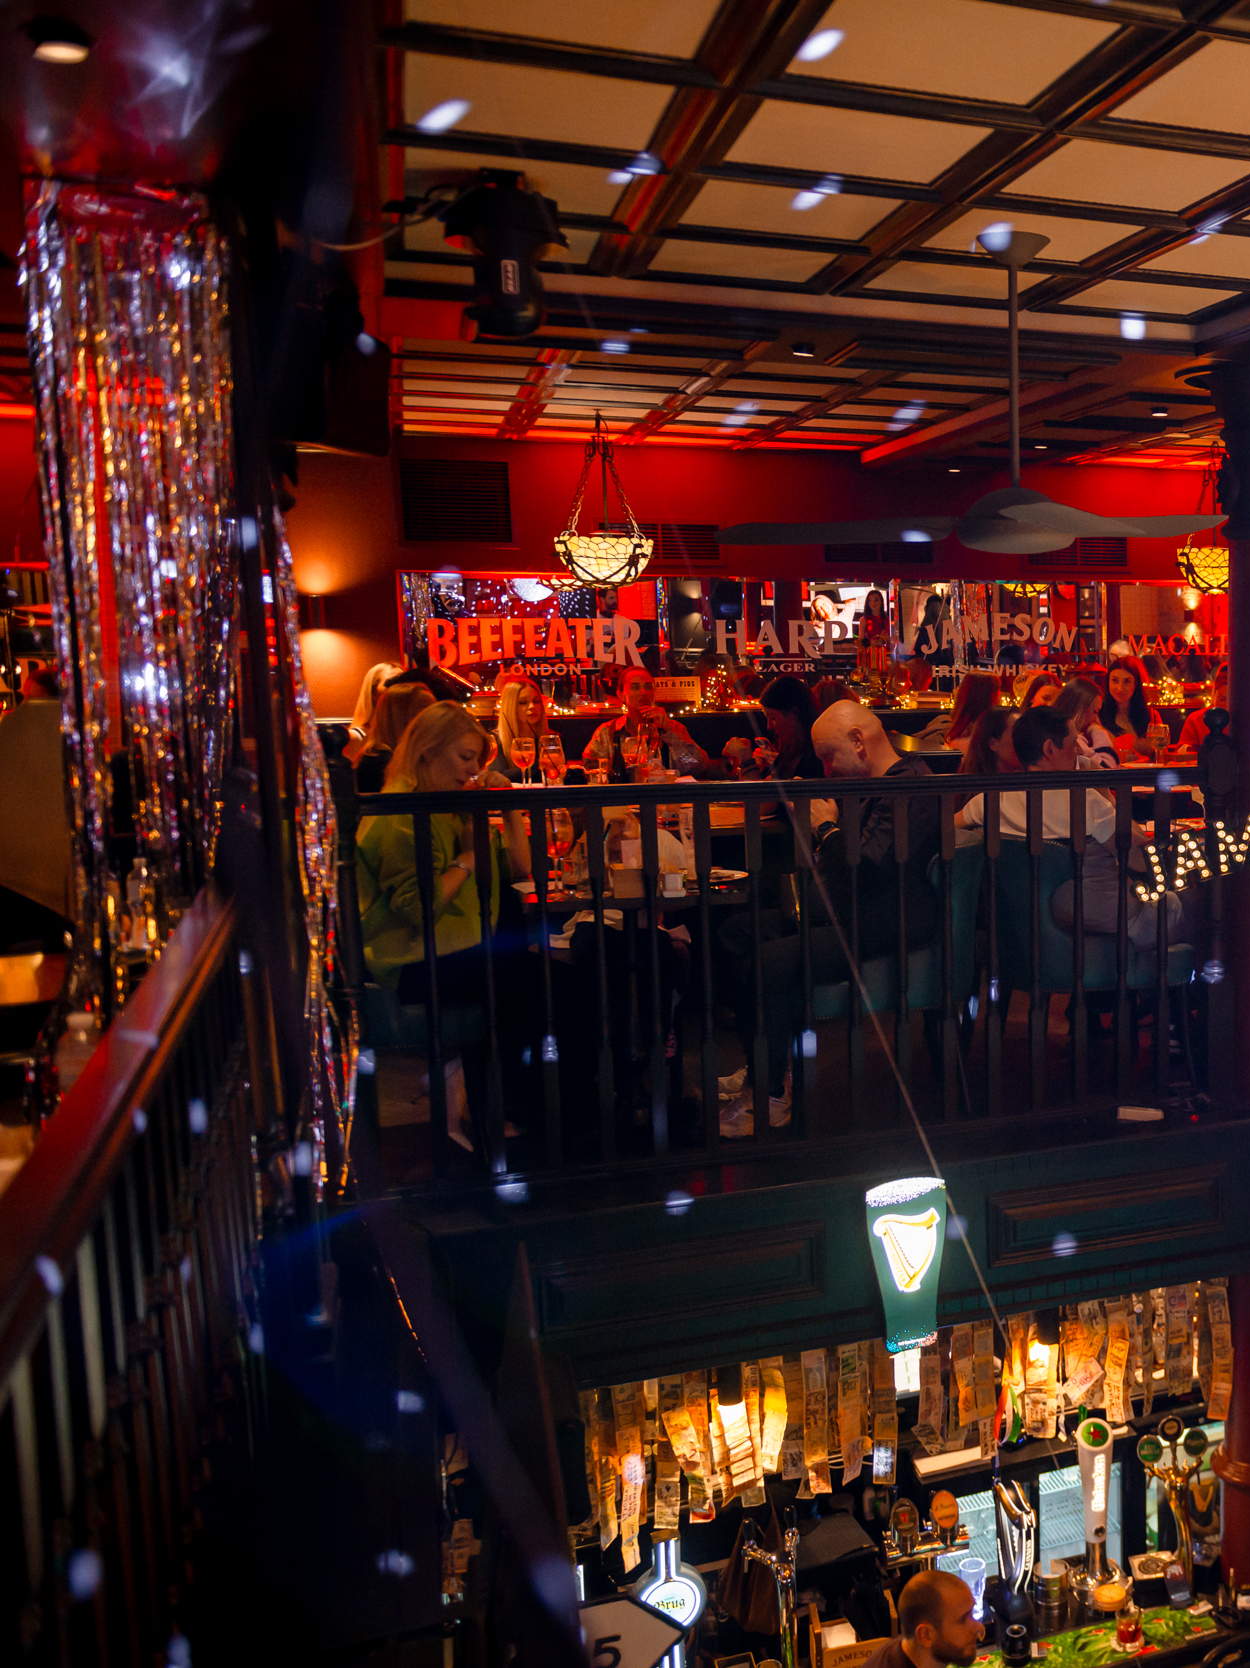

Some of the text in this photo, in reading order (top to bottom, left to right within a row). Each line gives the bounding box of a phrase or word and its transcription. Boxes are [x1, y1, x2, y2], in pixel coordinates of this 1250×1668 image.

[426, 617, 645, 670] BEEFEATER
[715, 619, 849, 659] HARP
[920, 612, 1079, 655] JAMESON
[1127, 633, 1229, 656] MACALL
[500, 663, 582, 677] LONDON
[755, 662, 816, 673] LAGER
[1091, 1453, 1106, 1512] Heineken
[832, 1649, 874, 1667] JAMESO
